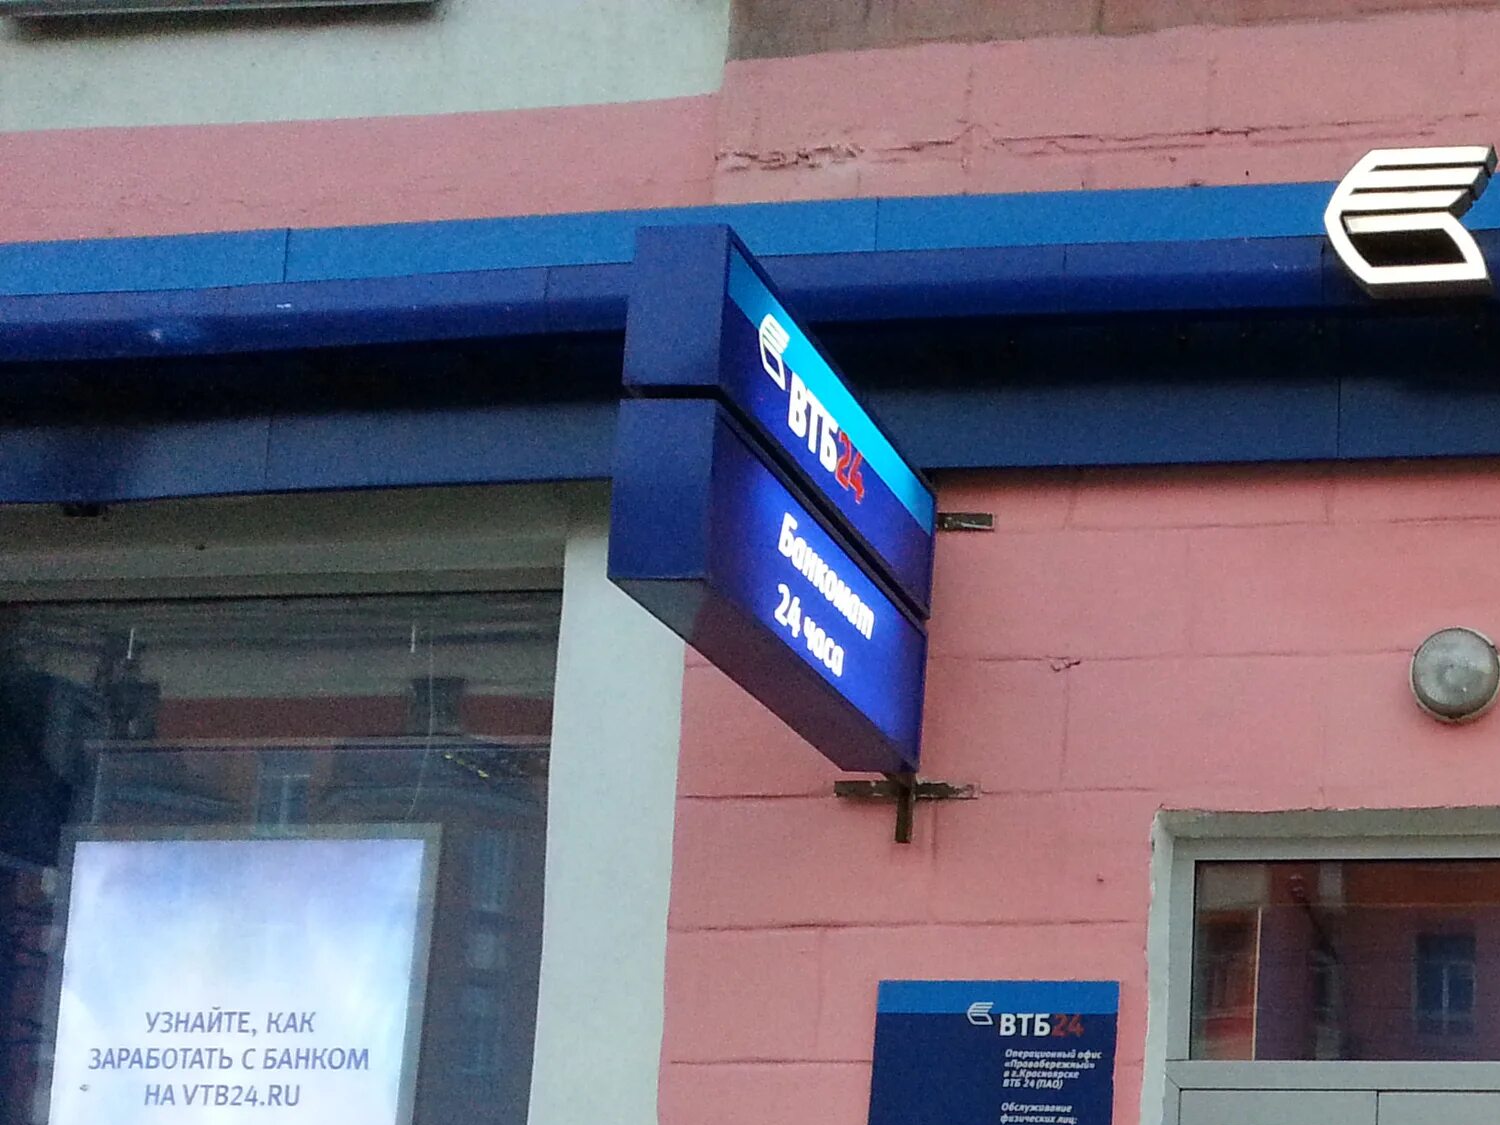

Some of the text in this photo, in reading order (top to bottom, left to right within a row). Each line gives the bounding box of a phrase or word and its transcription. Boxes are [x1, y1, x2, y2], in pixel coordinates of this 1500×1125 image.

[787, 371, 865, 504] ВТБ24
[778, 512, 875, 641] Банкомат
[774, 583, 845, 678] 24 часа
[145, 1006, 316, 1037] УЗНАЙТЕ, КАК
[999, 1013, 1085, 1037] ВТБ24
[88, 1047, 369, 1071] ЗАРАБОТАТЬ С БАНКОМ
[1077, 1049, 1103, 1063] офис
[144, 1083, 301, 1107] НА VTB24.RU
[1036, 1078, 1064, 1090] (ПАО)
[1000, 1102, 1073, 1114] Обслуживание
